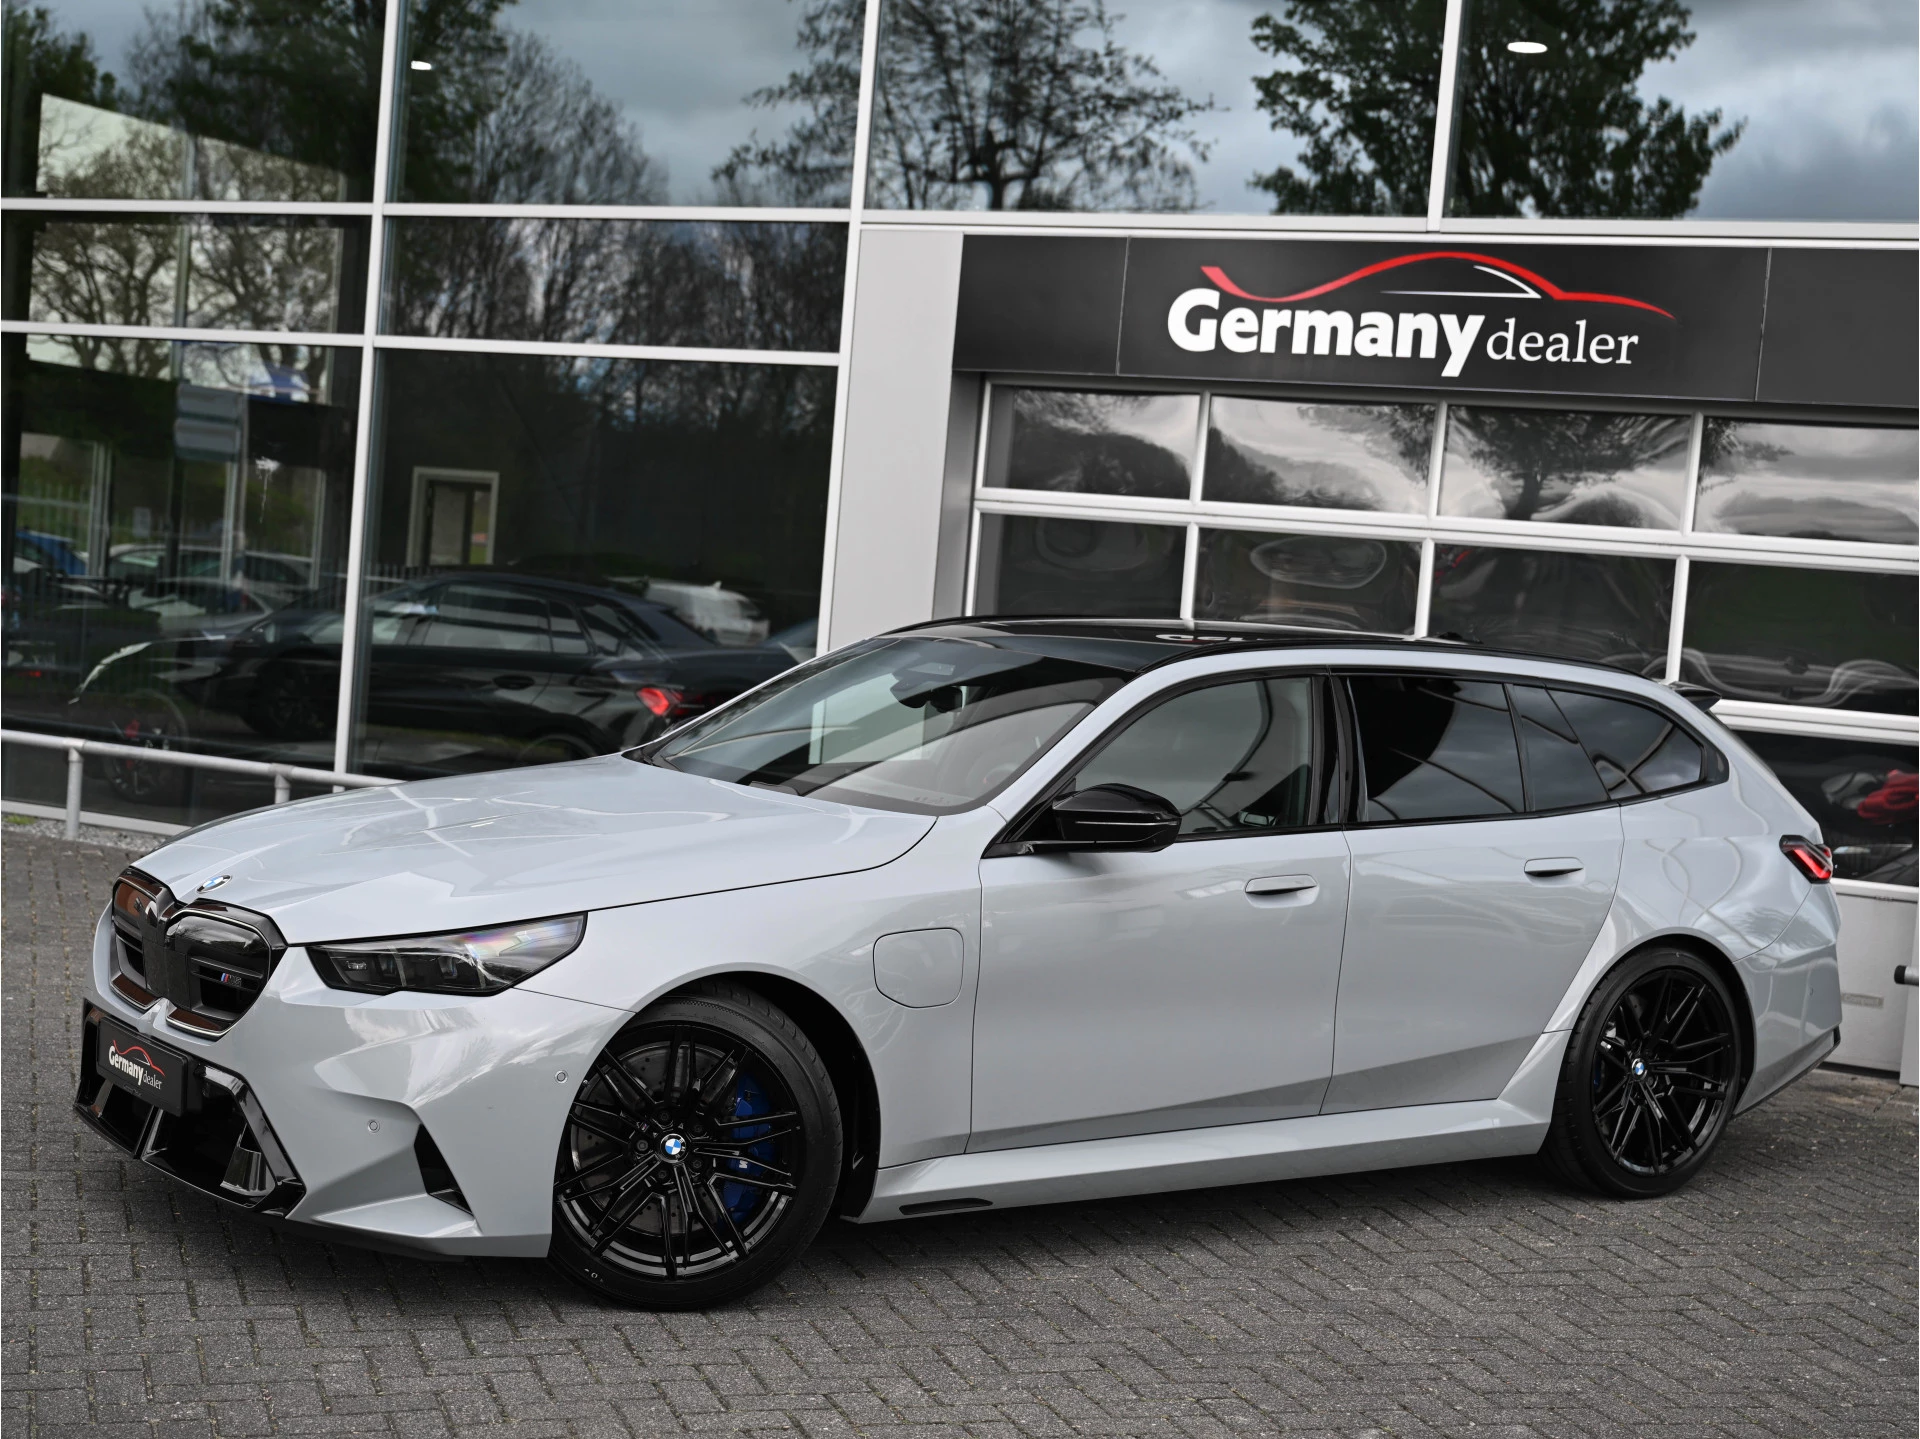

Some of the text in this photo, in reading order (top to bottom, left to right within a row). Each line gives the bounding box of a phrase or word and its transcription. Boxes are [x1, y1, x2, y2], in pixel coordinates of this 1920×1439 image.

[1167, 287, 1639, 377] Germany dealer
[108, 1045, 162, 1090] Germany dealer
